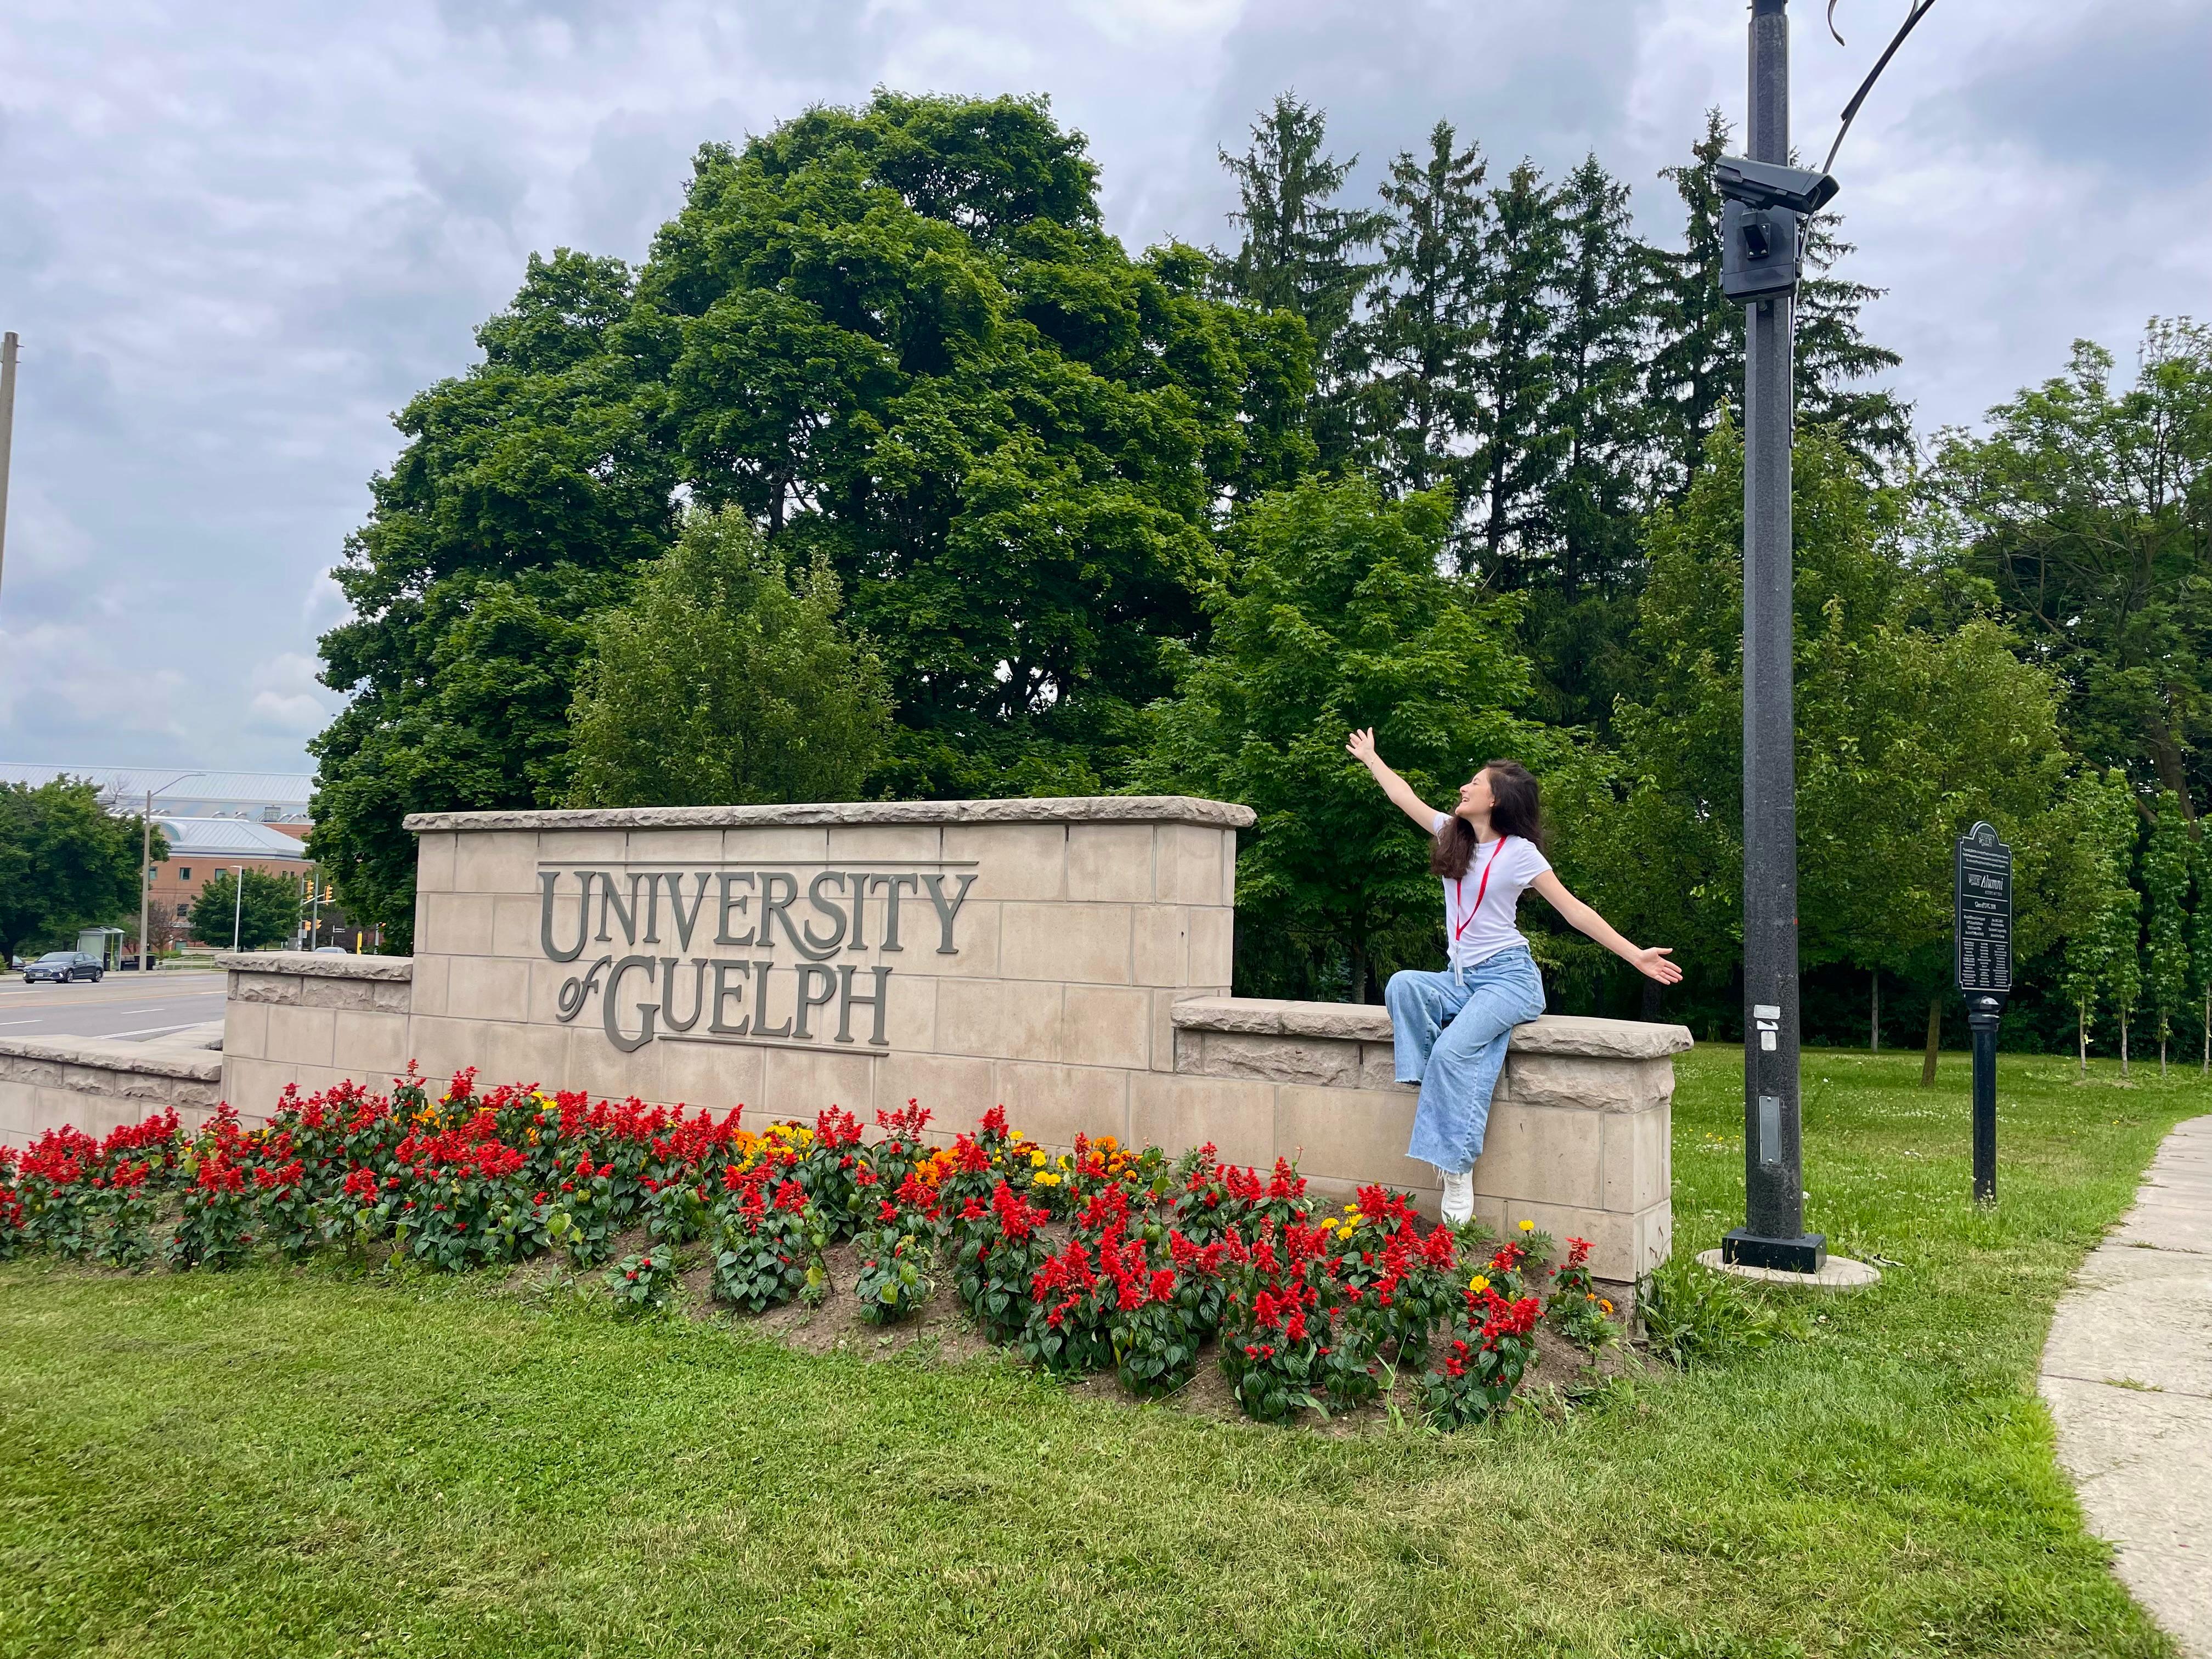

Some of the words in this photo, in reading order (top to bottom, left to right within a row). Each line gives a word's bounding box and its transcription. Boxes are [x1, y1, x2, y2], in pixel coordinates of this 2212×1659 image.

[538, 871, 979, 962] UNIVERSITY
[1980, 874, 2004, 890] Alumni
[556, 955, 612, 1022] of
[603, 955, 894, 1052] GUELPH
